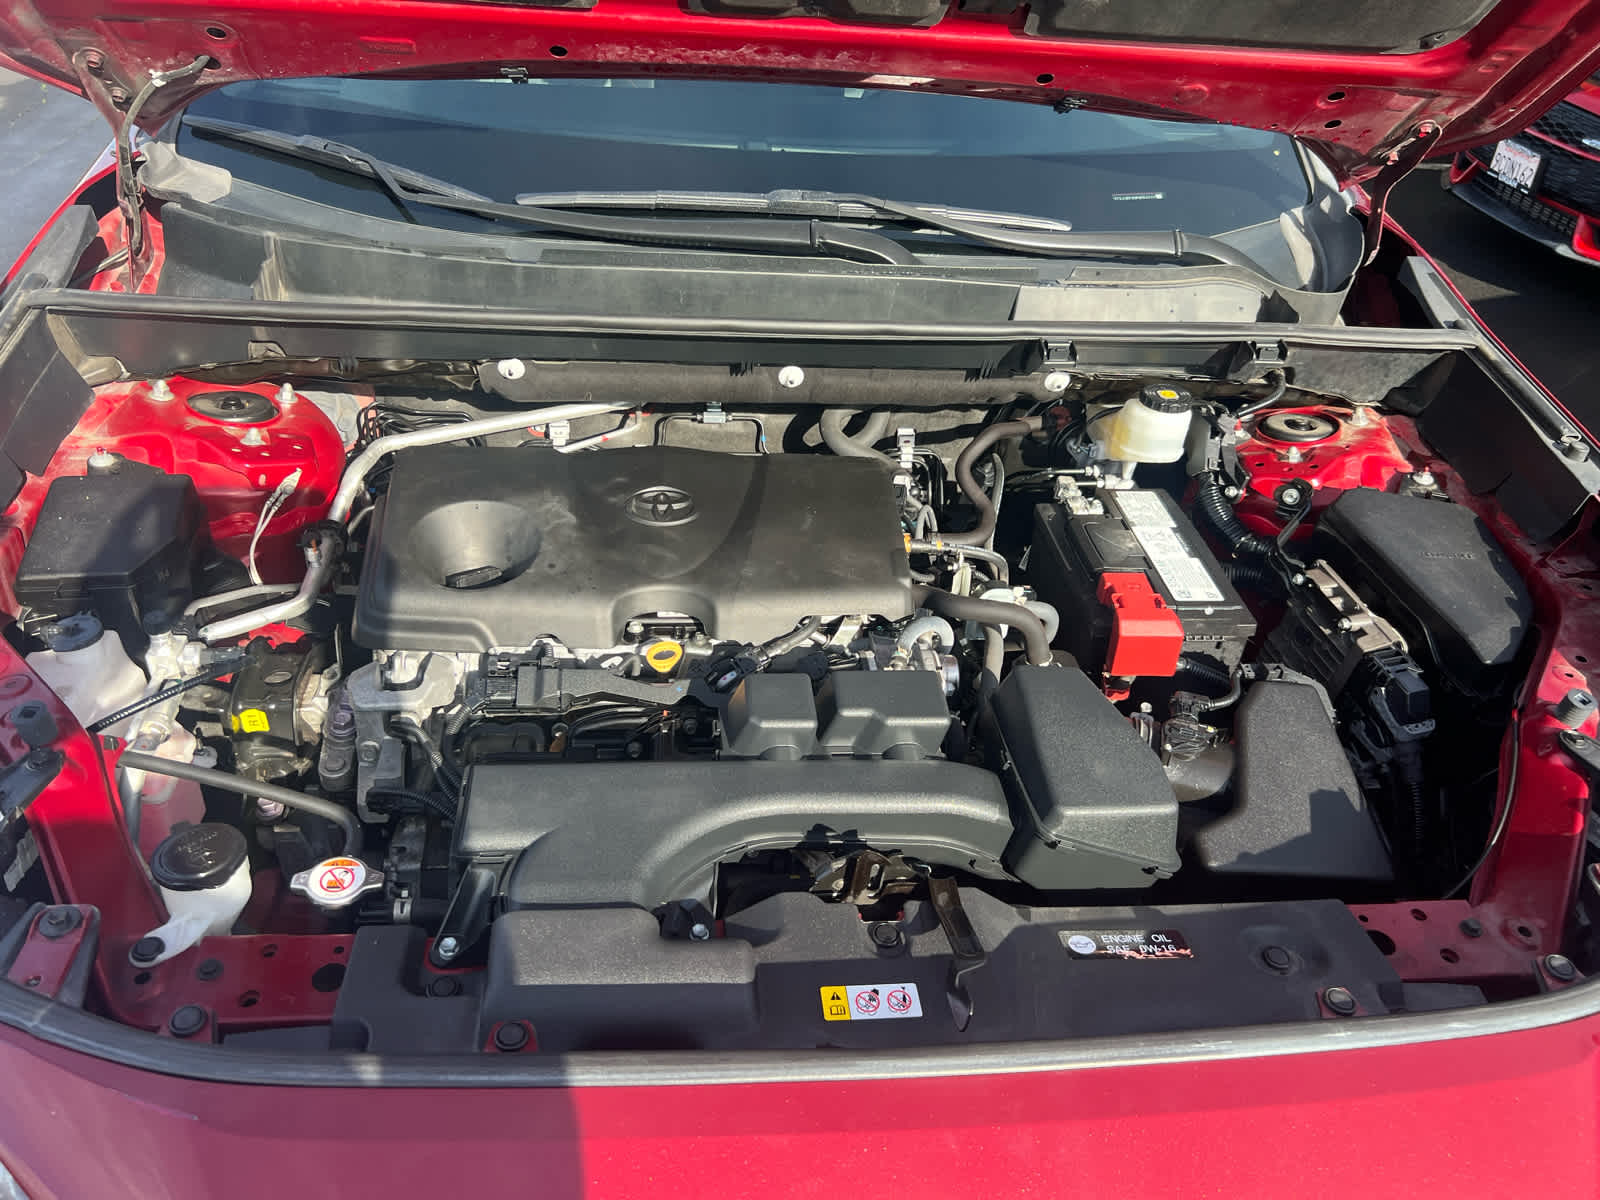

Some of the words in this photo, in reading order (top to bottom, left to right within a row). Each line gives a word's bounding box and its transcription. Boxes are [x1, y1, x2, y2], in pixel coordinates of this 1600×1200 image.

[1101, 934, 1145, 943] ENGINE
[1151, 934, 1172, 943] OIL
[1139, 944, 1177, 953] 0W-16
